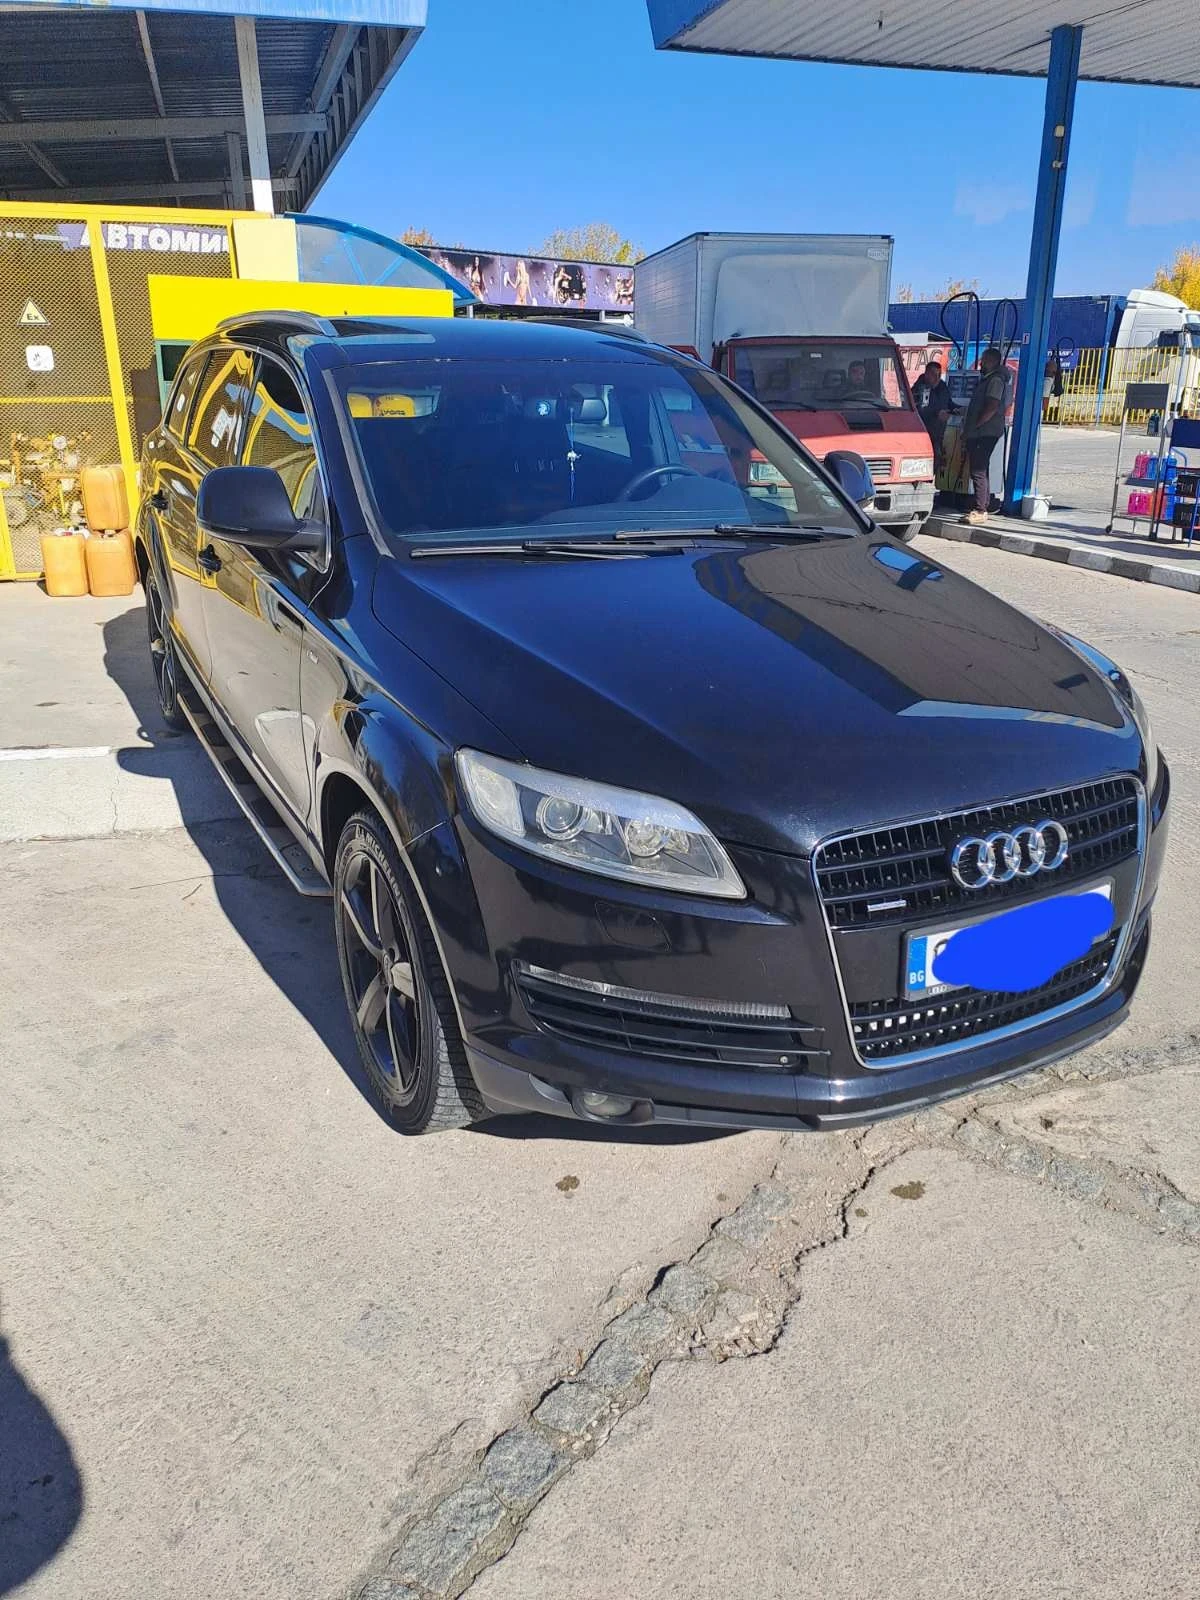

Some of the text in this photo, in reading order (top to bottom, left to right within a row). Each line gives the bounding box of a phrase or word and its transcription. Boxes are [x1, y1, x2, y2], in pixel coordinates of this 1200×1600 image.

[80, 222, 229, 253] ВТОМИ
[26, 313, 39, 321] Ex
[365, 831, 402, 898] MICHELIN
[909, 970, 925, 985] BG
